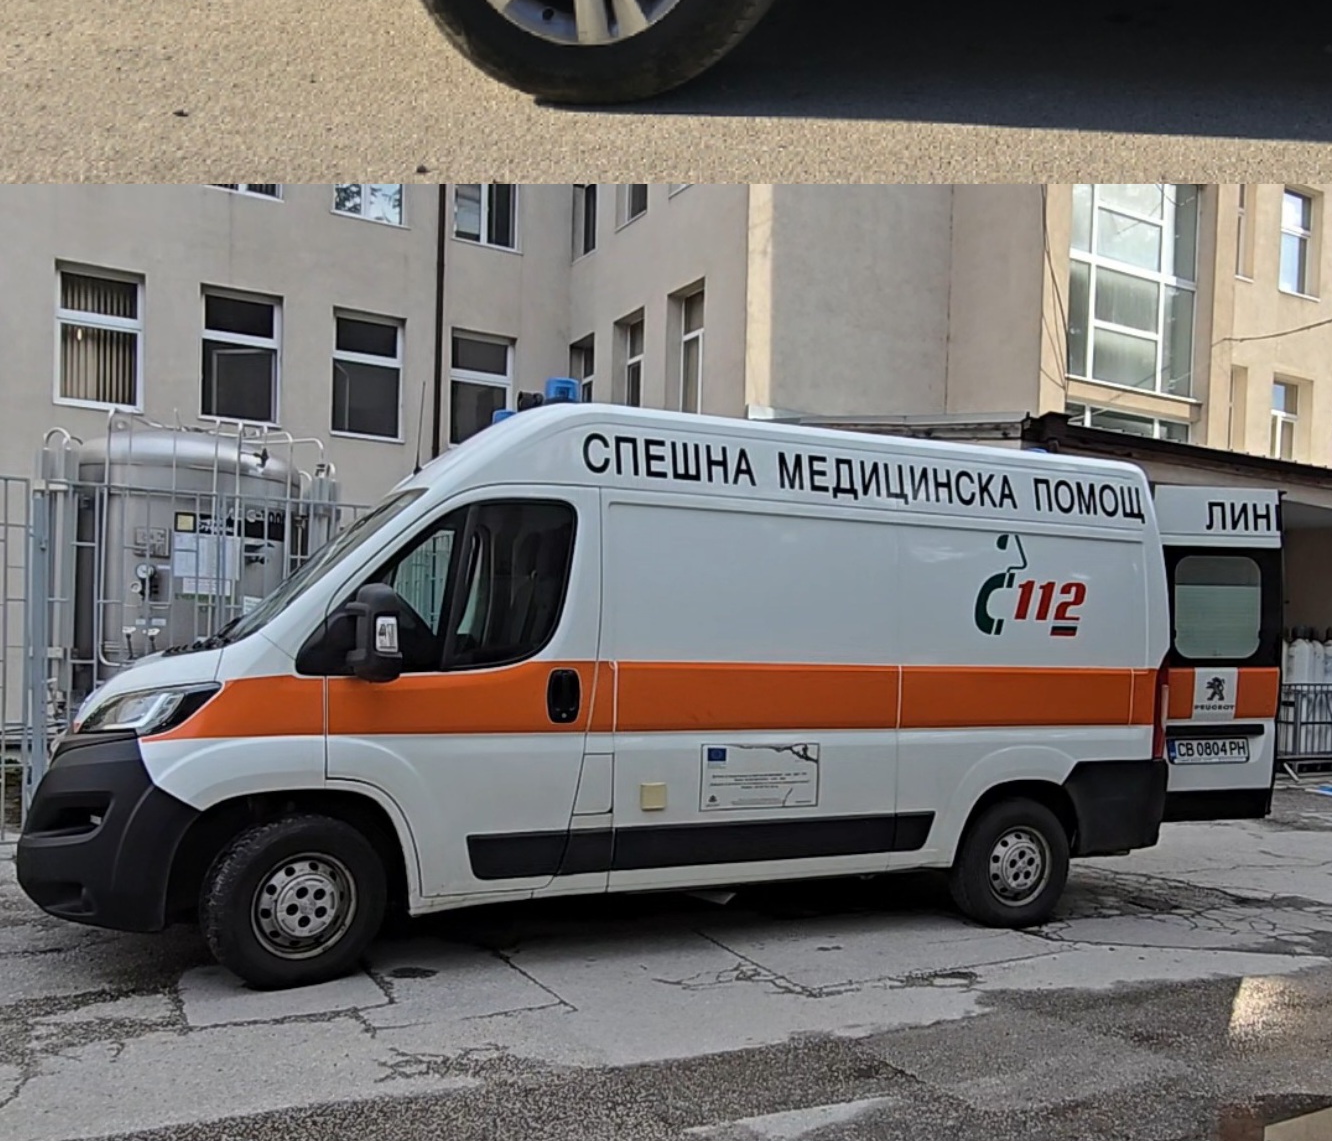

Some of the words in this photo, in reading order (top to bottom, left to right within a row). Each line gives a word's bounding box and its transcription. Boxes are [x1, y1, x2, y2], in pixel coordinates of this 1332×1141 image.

[583, 433, 757, 487] СПЕШНА
[778, 451, 1018, 510] МЕДИЦИНСКА
[1033, 477, 1146, 524] ПОМОЩ
[1206, 501, 1281, 531] ЛИН
[1014, 580, 1087, 621] 112
[1197, 741, 1227, 756] 0804
